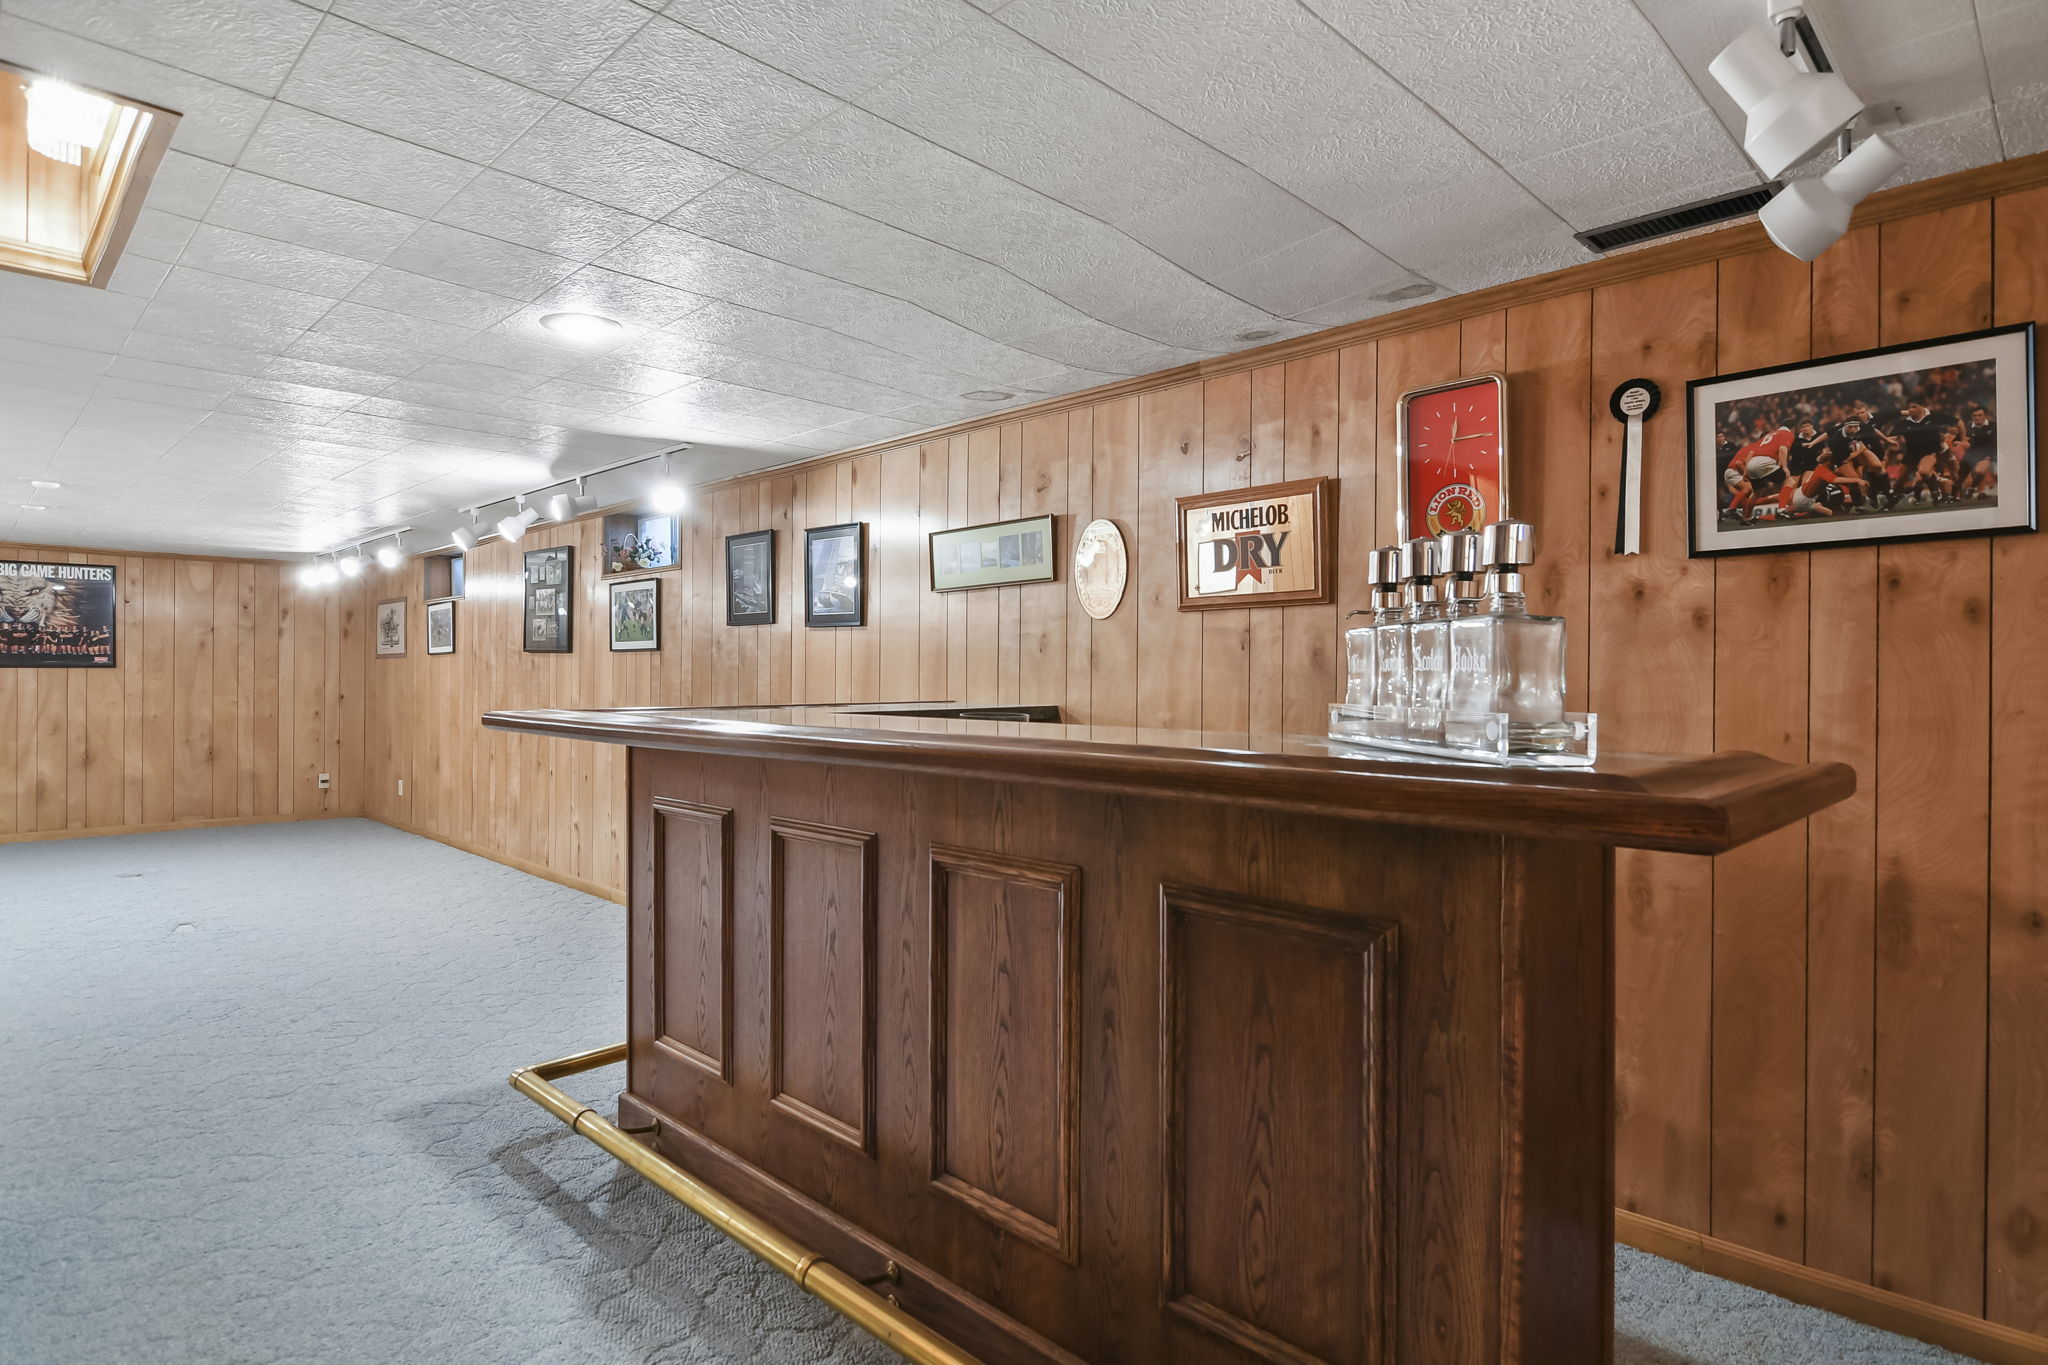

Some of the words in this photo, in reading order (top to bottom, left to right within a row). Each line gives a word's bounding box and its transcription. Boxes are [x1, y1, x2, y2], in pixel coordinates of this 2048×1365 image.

[1430, 487, 1457, 513] LION
[1457, 487, 1481, 508] RED
[1212, 503, 1289, 532] MICHELOB
[1213, 530, 1291, 573] DRY
[0, 563, 18, 577] BIG
[20, 564, 55, 578] GAME
[58, 566, 112, 581] HUNTERS
[1453, 645, 1487, 673] Vodka
